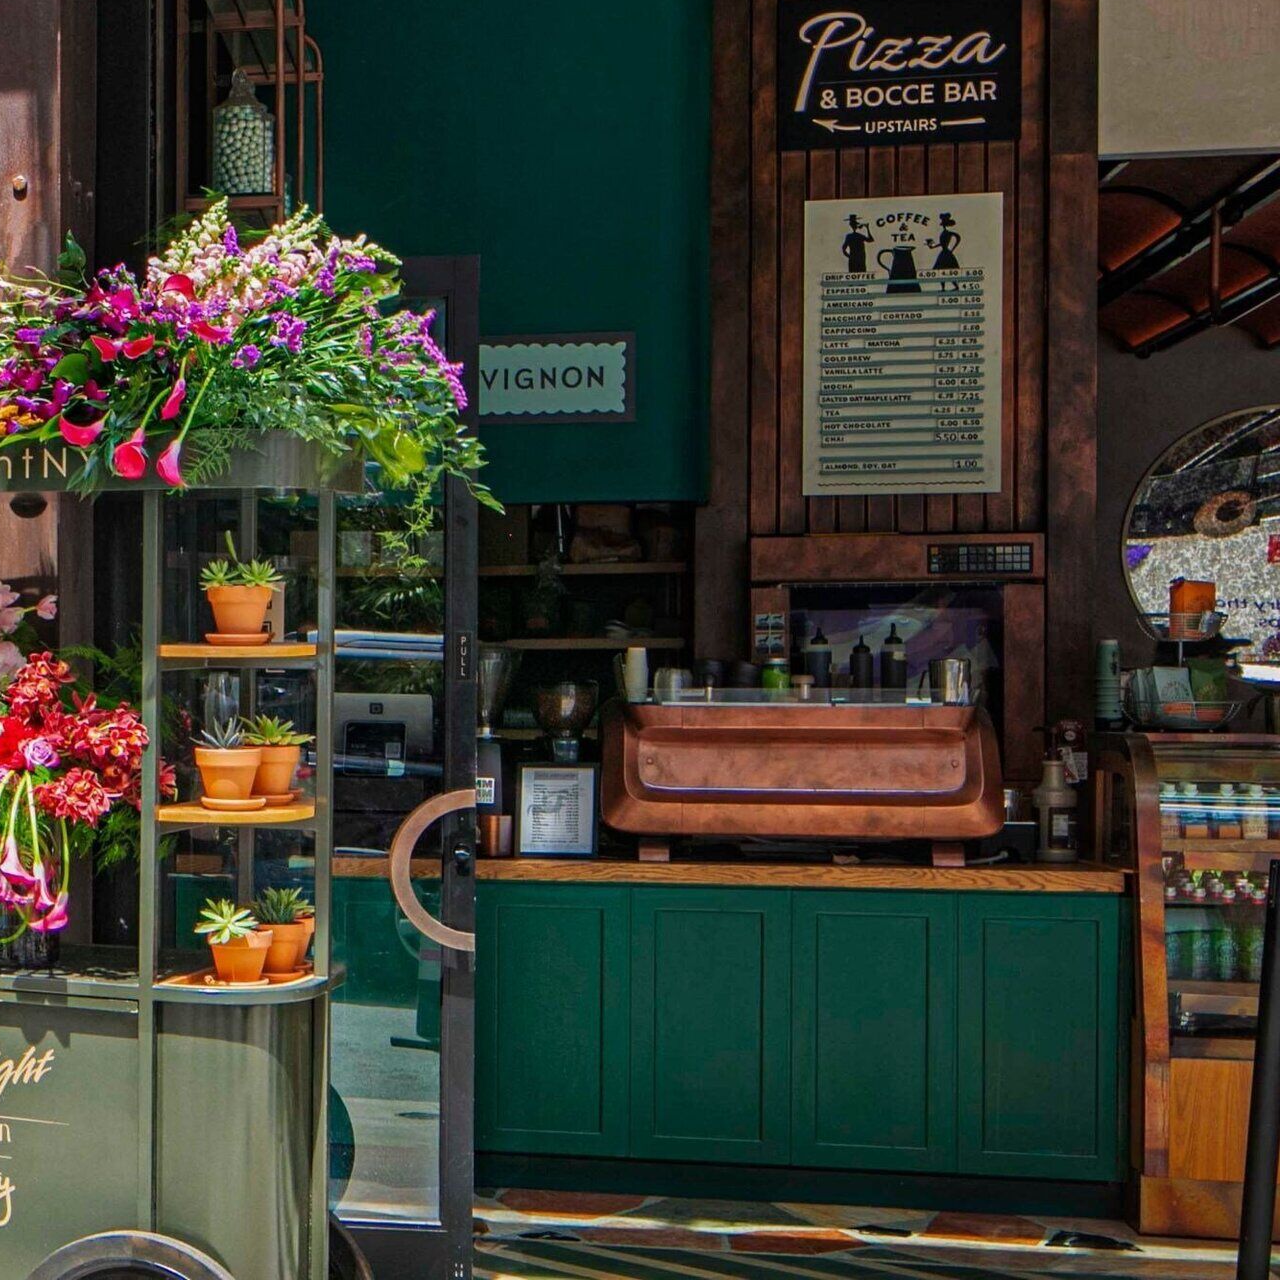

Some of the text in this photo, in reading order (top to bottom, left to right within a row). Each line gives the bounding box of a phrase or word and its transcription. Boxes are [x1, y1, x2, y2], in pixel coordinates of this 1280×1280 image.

[794, 11, 1006, 112] Pizza
[820, 81, 997, 109] & BOCCE BAR
[865, 118, 937, 134] UPSTAIRS
[876, 212, 930, 228] COFFEE
[899, 222, 908, 231] &
[891, 233, 916, 242] TEA
[826, 287, 866, 295] ESPRESSO
[826, 300, 874, 308] AMERICANO
[883, 312, 922, 320] CORTADO
[824, 327, 877, 335] CAPPUCCINO
[868, 340, 900, 348] MATCHA
[824, 355, 846, 363] COLD
[858, 367, 883, 375] LATTE
[480, 366, 605, 390] VIGNON
[849, 395, 863, 403] OAT
[889, 394, 912, 402] LATTE
[825, 409, 840, 417] TEA
